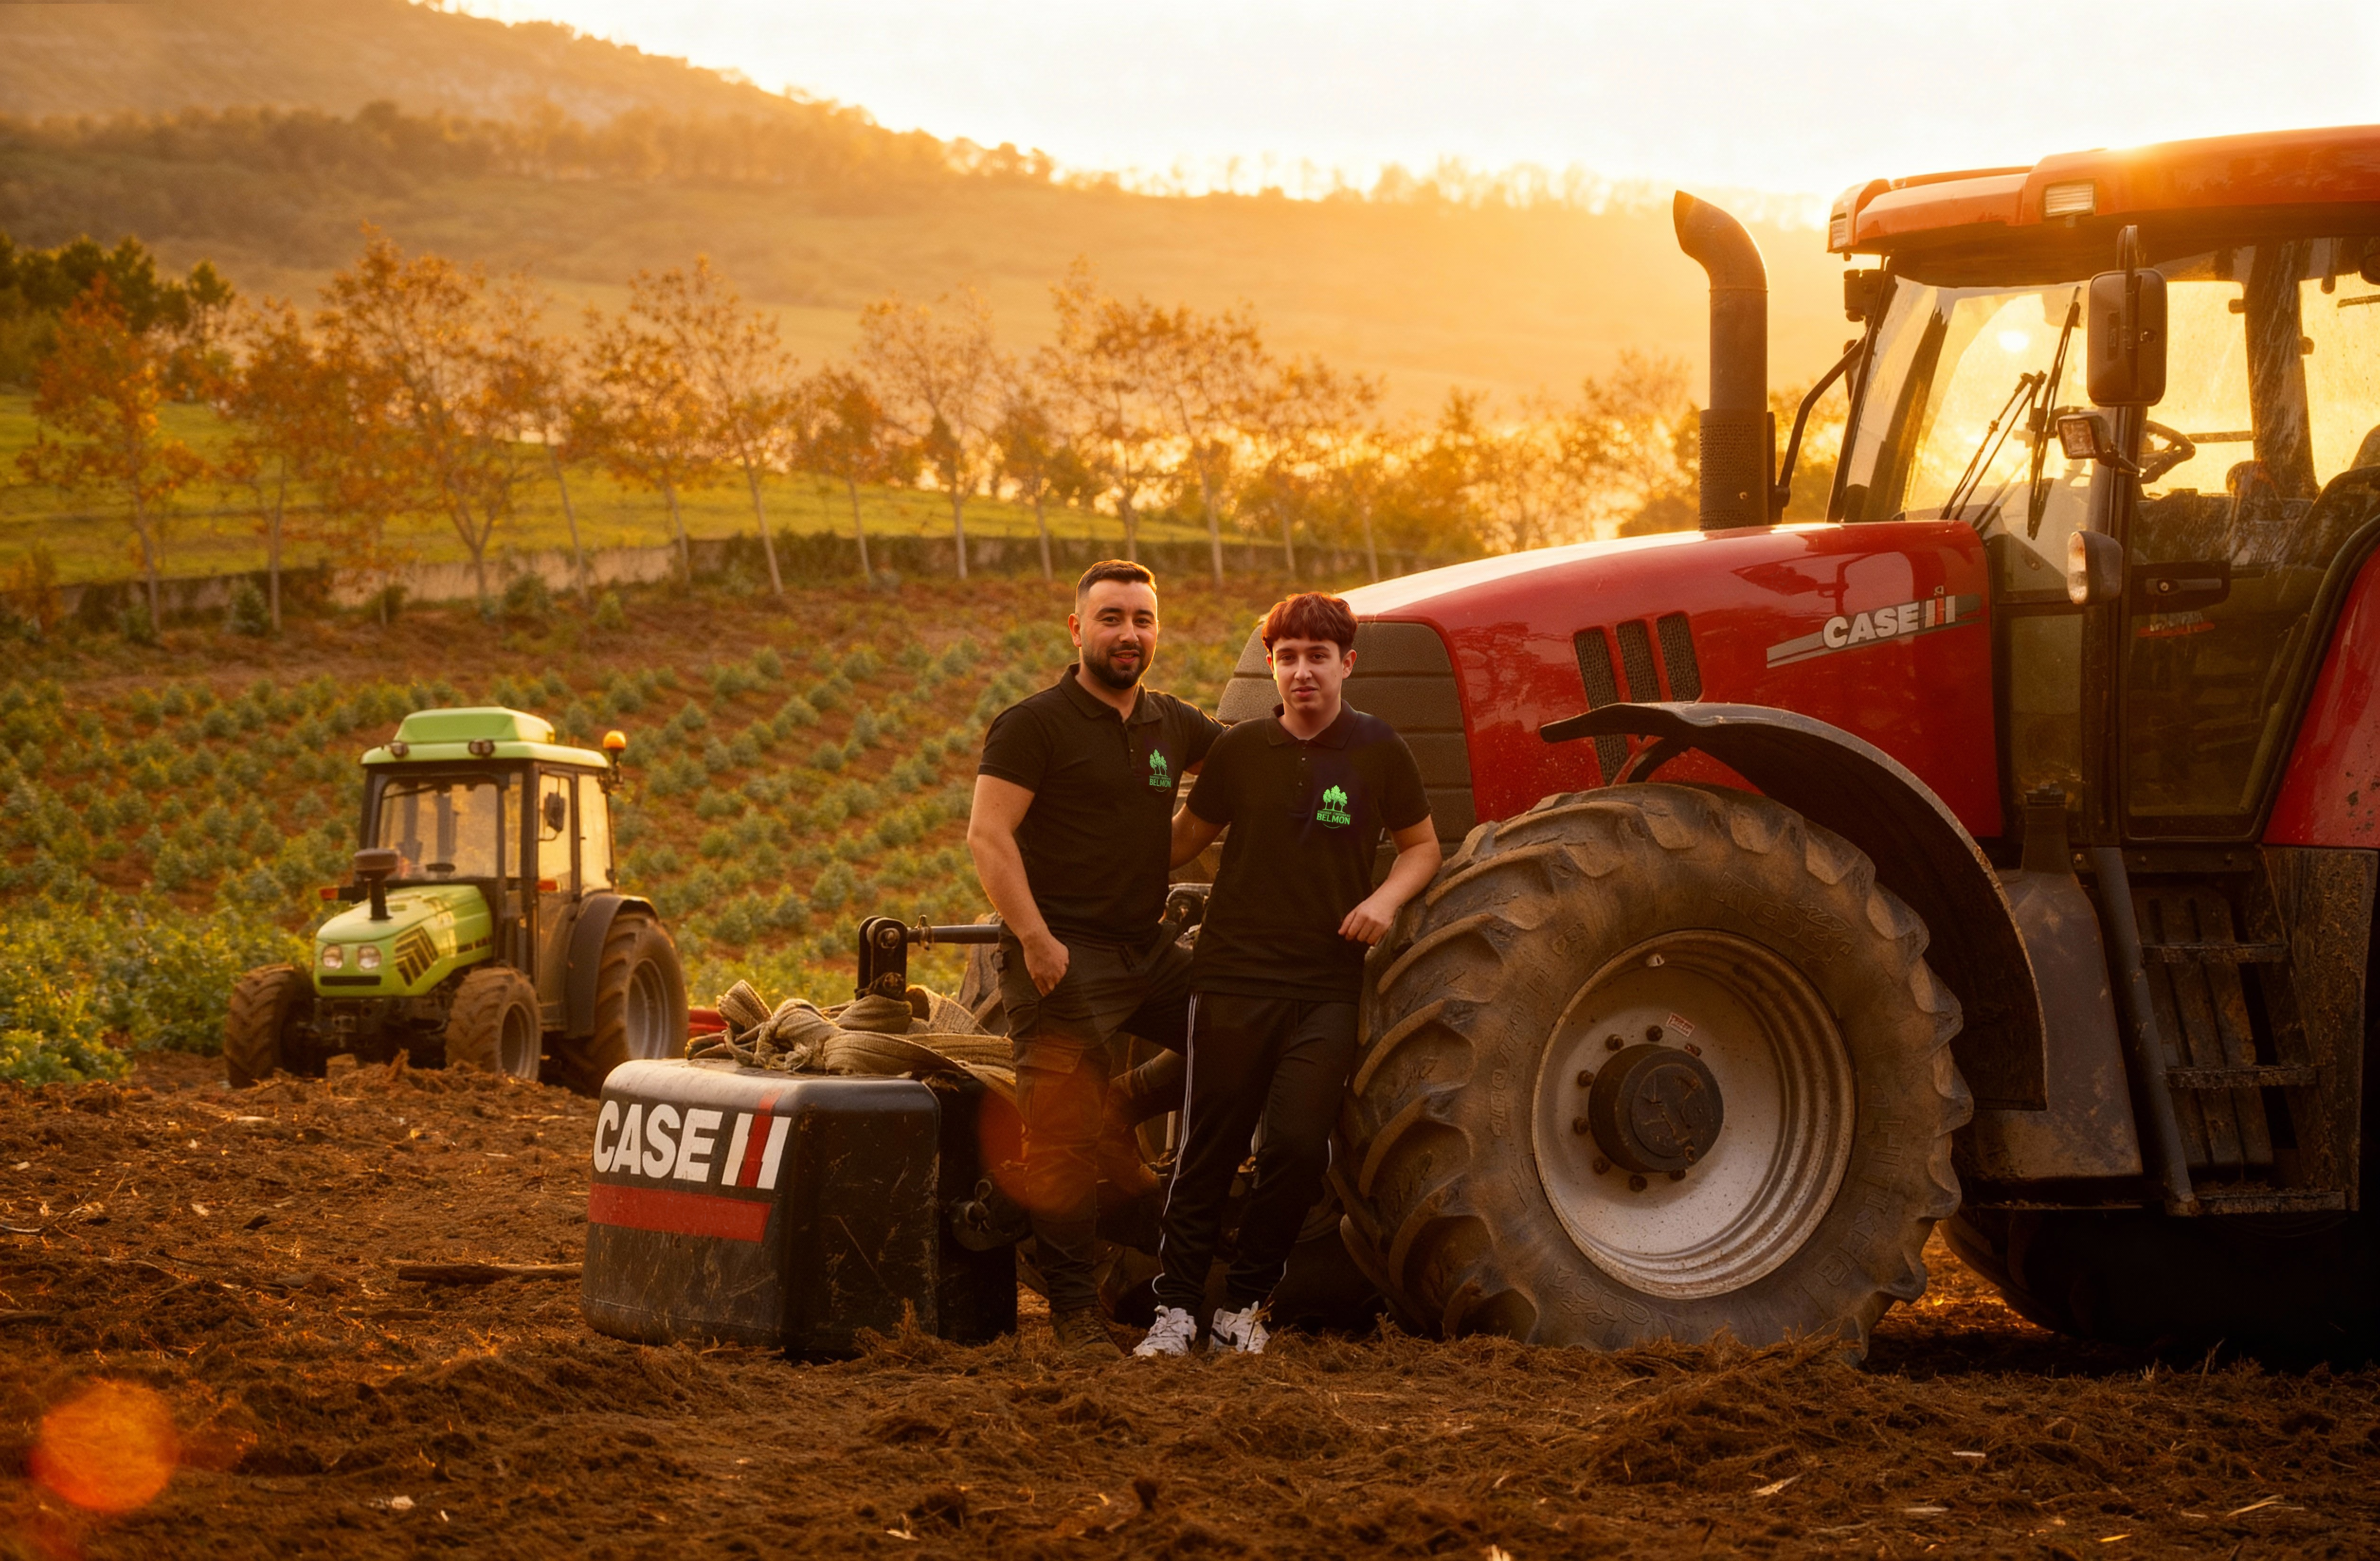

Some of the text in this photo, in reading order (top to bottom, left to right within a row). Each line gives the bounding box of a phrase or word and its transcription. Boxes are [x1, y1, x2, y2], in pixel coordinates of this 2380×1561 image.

[1822, 602, 1919, 649] CASE
[1149, 778, 1171, 788] BELMON
[1316, 813, 1350, 825] BELMON
[594, 1100, 723, 1182] CASE
